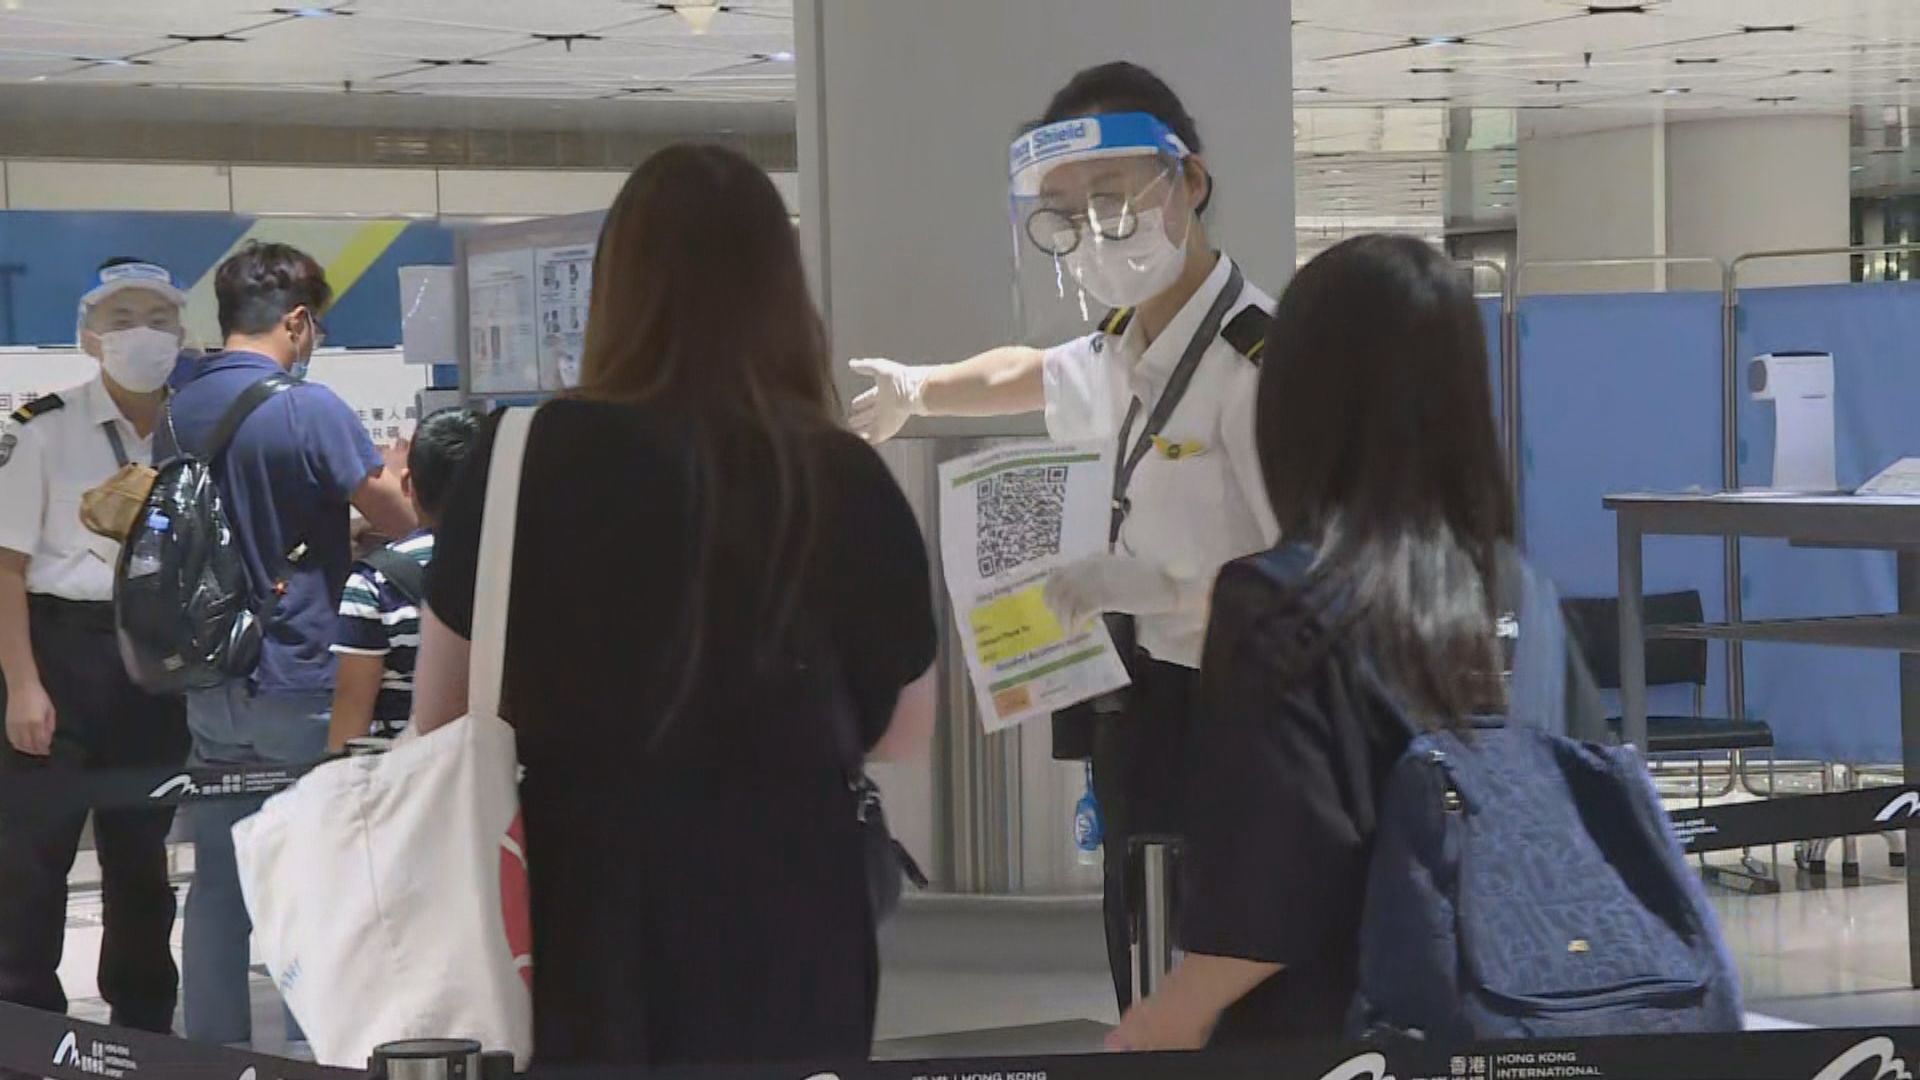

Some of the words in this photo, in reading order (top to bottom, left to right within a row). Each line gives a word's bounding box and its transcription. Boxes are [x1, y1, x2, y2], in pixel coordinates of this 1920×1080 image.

[1033, 121, 1085, 144] Shield
[1450, 1055, 1486, 1075] 香港
[1496, 1054, 1535, 1065] HONG
[1538, 1052, 1576, 1063] KONG
[1006, 1071, 1047, 1080] KONG
[1496, 1065, 1602, 1079] INTERNATIONAL
